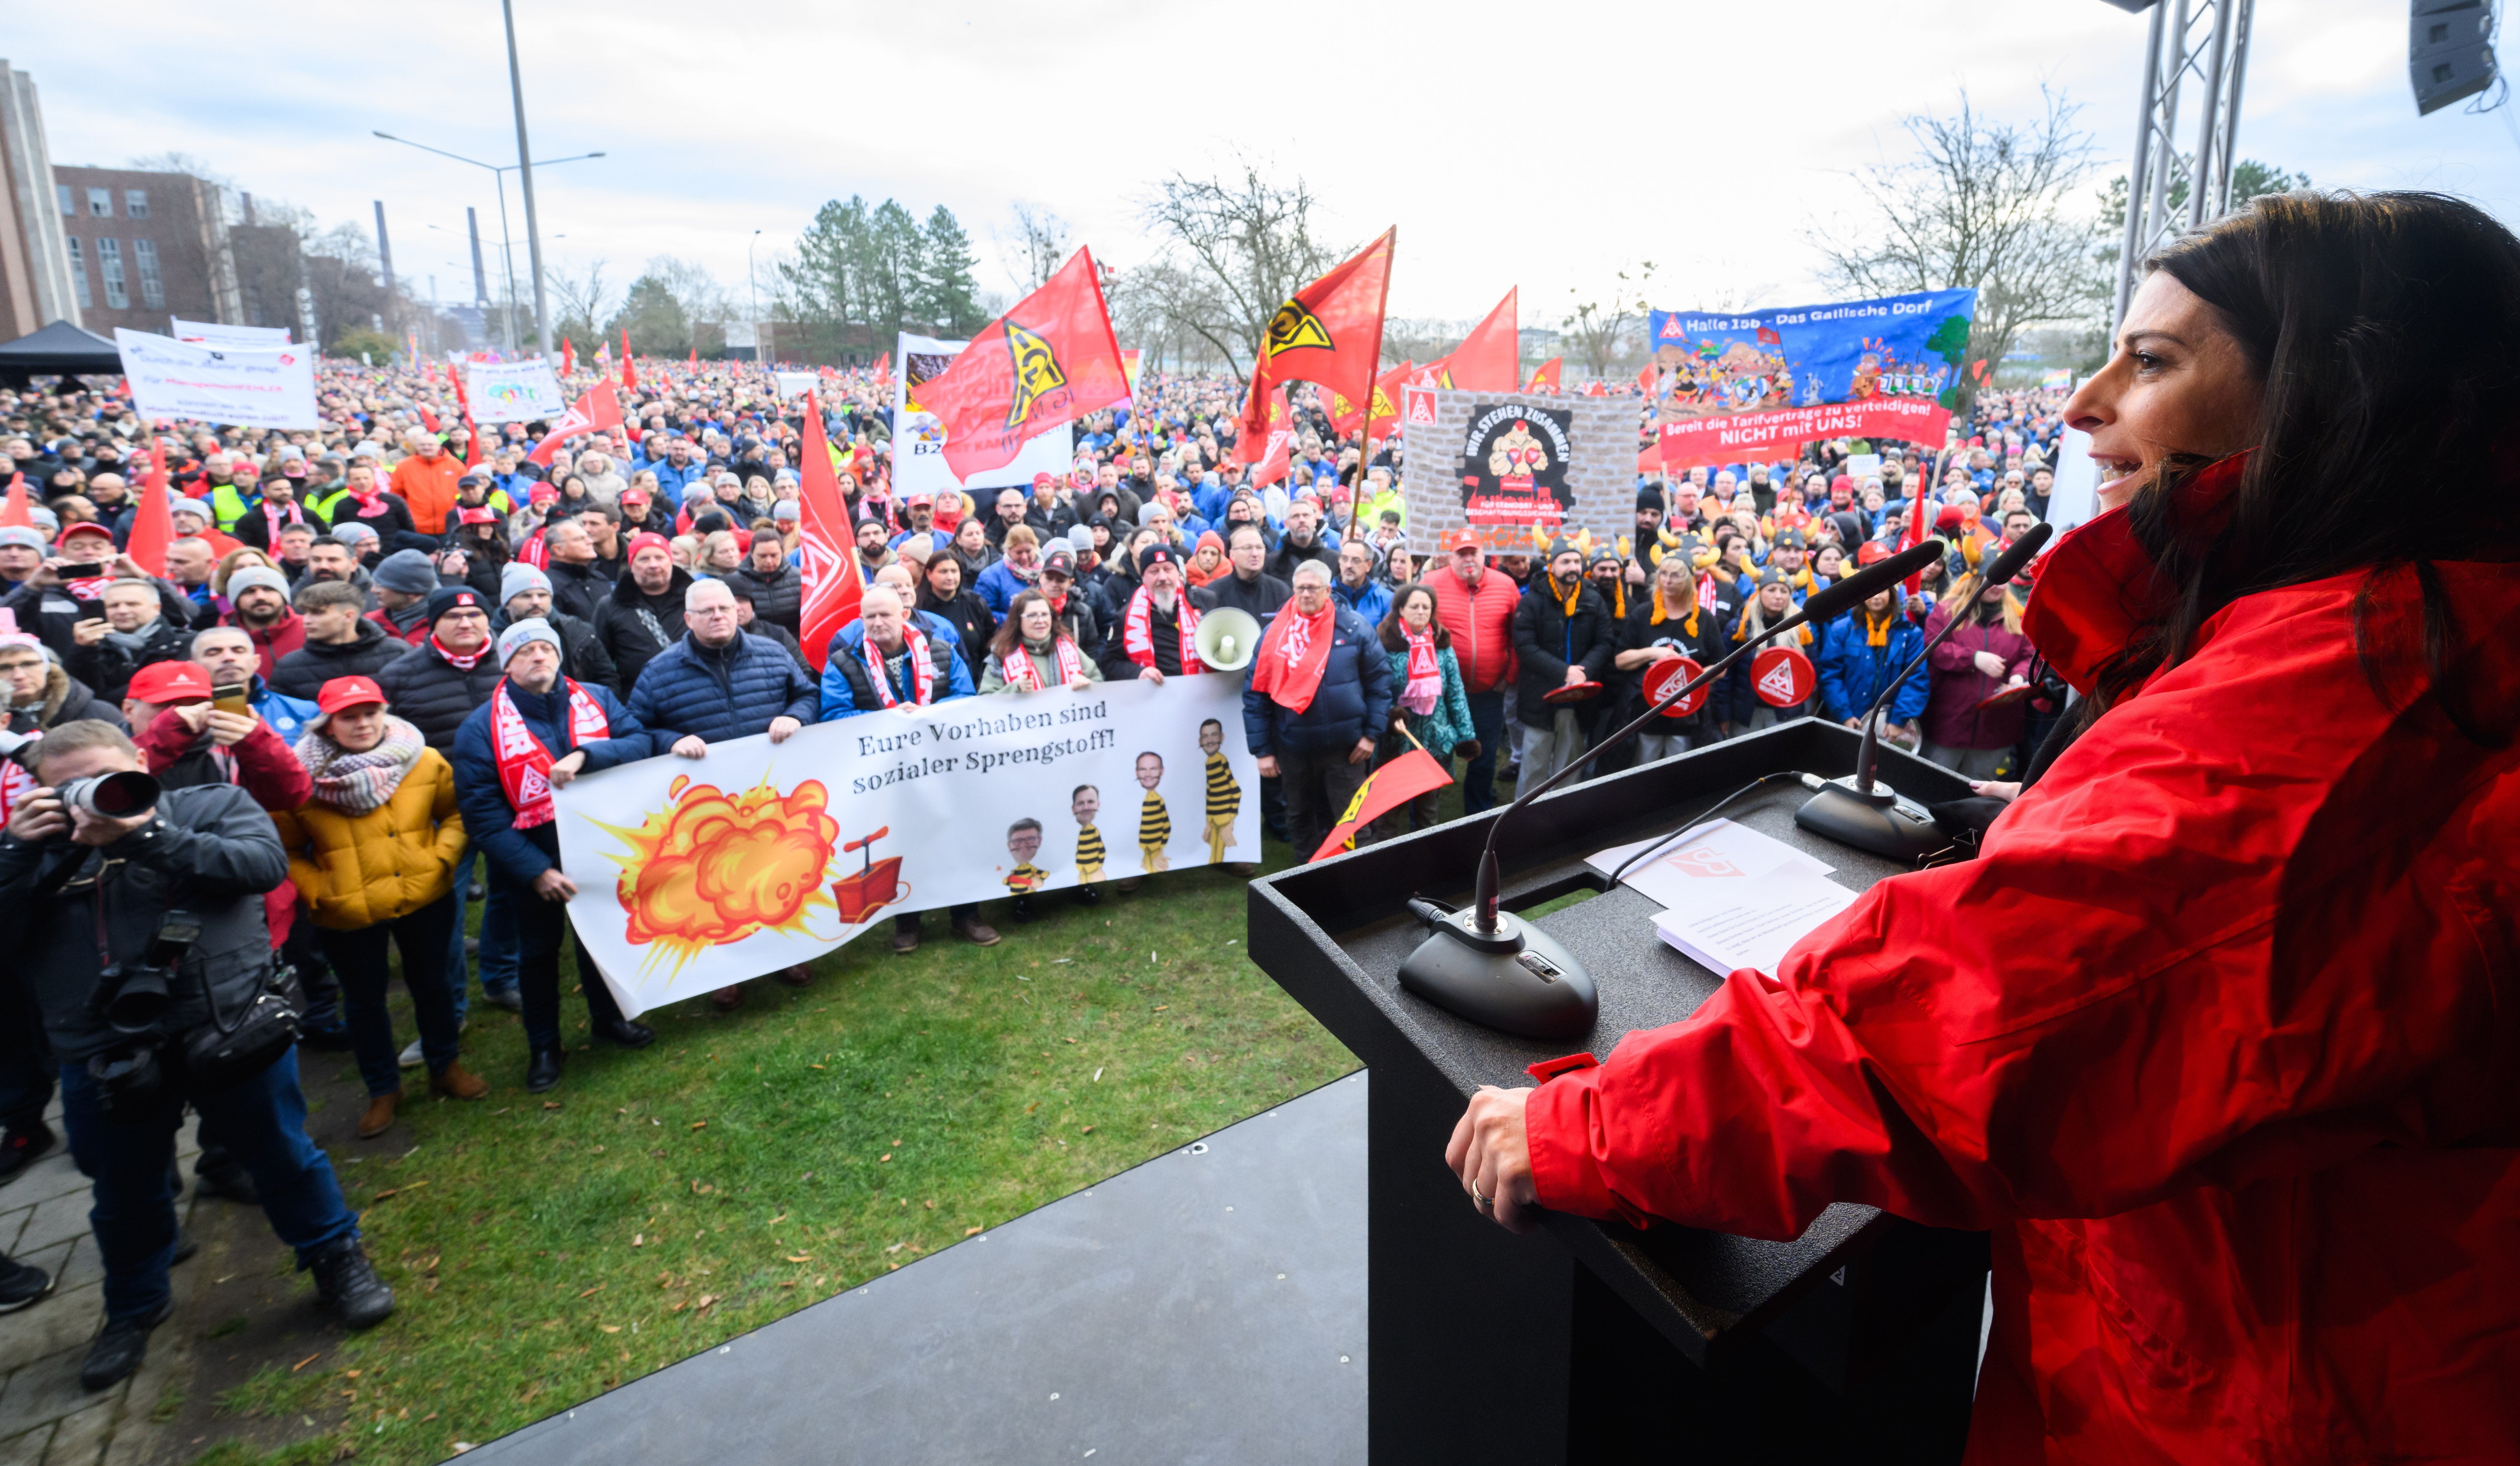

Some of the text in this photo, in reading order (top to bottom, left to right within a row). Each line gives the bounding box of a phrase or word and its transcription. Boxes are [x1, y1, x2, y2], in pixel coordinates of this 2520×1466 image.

[1687, 319, 1728, 332] Halle
[1731, 318, 1761, 330] 15b
[1776, 313, 1806, 325] Das
[1810, 305, 1887, 321] Gallische
[1892, 299, 1932, 315] Dorf
[1465, 405, 1570, 462] WIR STEHEN ZUSAMMEN
[1667, 399, 1931, 436] Bereit die Tarifverträge zu verteidigen!
[1720, 414, 1862, 445] NICHT mit UNS!
[1465, 508, 1569, 519] BESCHÄFTIGUNGSSICHERUNG
[1480, 500, 1495, 509] FÜR
[1495, 501, 1533, 510] STANDORT
[857, 700, 1107, 757] Eure Vorhaben sind
[853, 729, 1116, 795] sozialer Sprengstoff!
